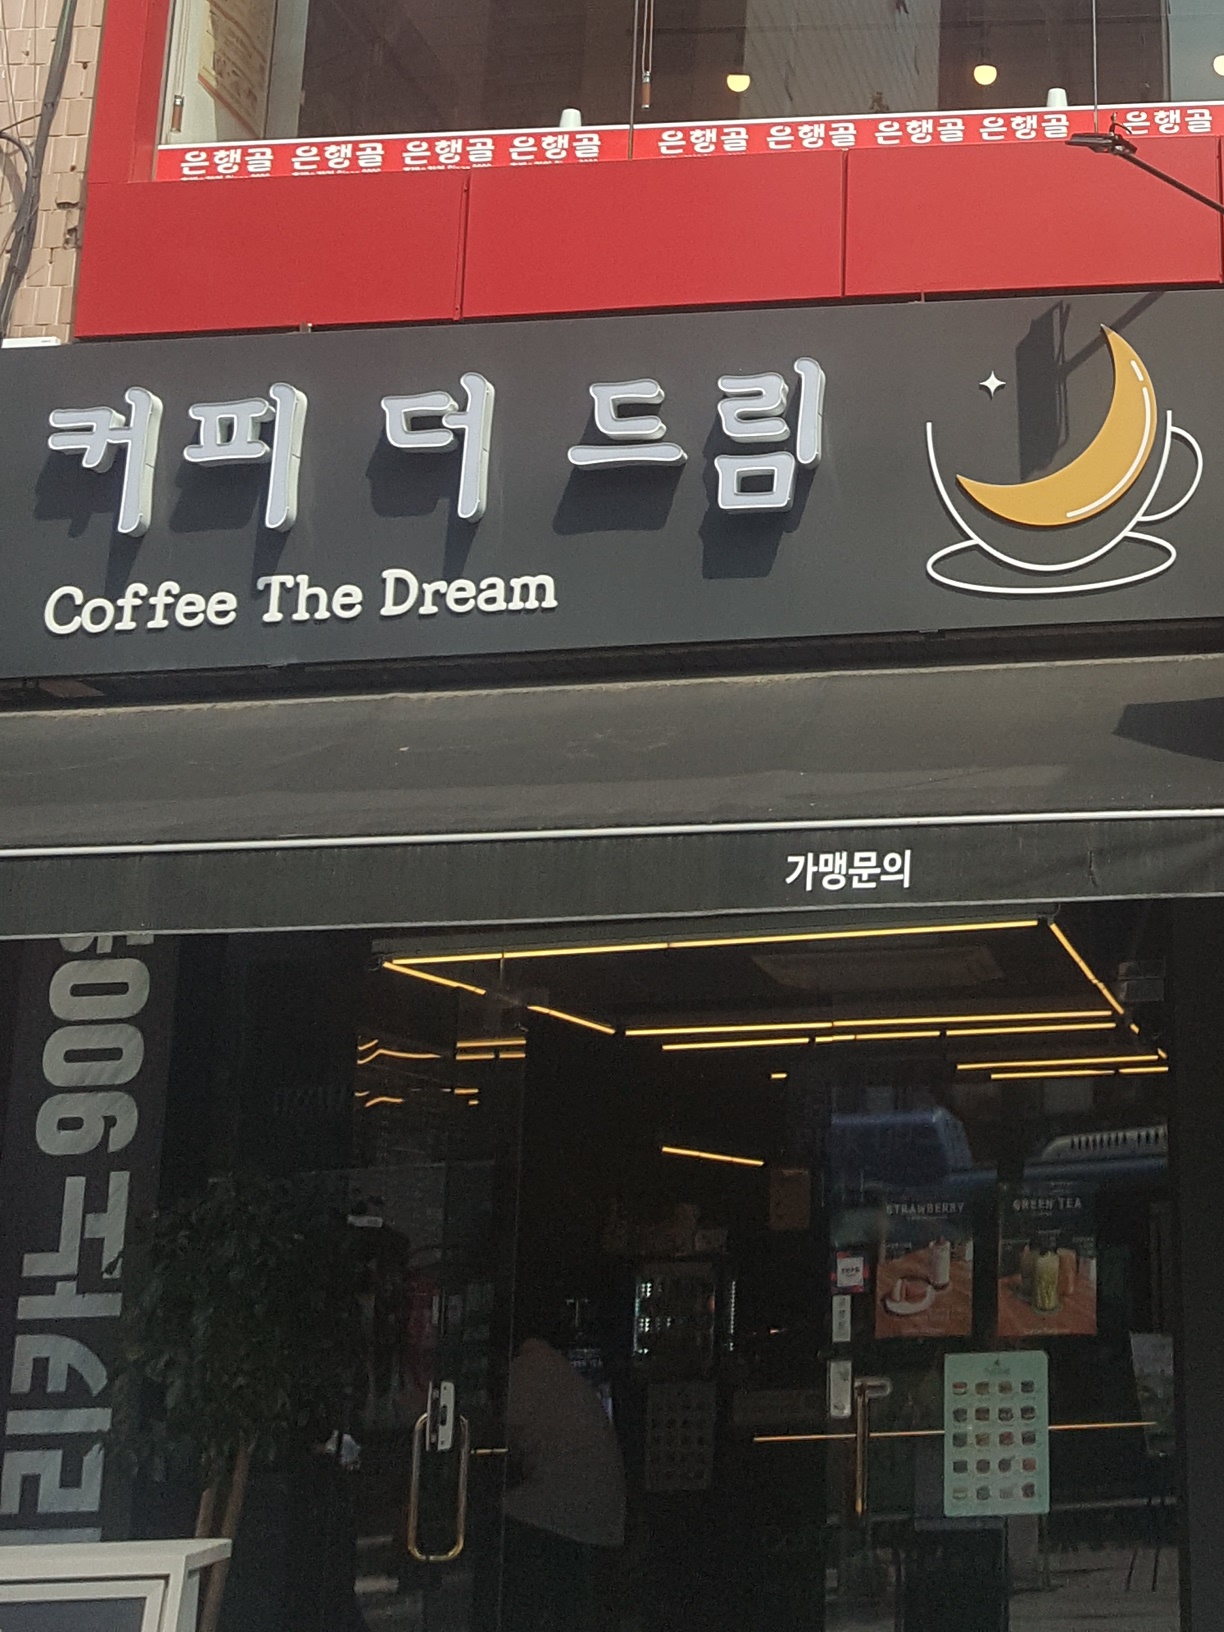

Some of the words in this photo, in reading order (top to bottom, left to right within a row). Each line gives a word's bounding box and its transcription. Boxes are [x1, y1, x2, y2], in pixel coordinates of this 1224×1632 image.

[765, 121, 858, 150] 은행골
[874, 116, 966, 145] 은행골
[979, 111, 1070, 142] 은행골
[1123, 107, 1213, 136] 은행골
[402, 137, 495, 166] 은행골
[508, 133, 602, 161] 은행골
[658, 127, 750, 155] 은행골
[180, 147, 274, 174] 은행골
[291, 143, 385, 170] 은행골
[48, 381, 308, 537] 커피
[381, 371, 496, 523] 더
[567, 357, 826, 511] 드림
[44, 581, 238, 636] Coffee
[256, 574, 364, 624] The
[380, 568, 559, 617] Dream
[784, 848, 913, 892] 가맹문의
[36, 935, 154, 1156] 900
[1012, 1198, 1055, 1211] GREEN
[1057, 1196, 1083, 1210] TEA
[0, 1171, 130, 1543] 리카노
